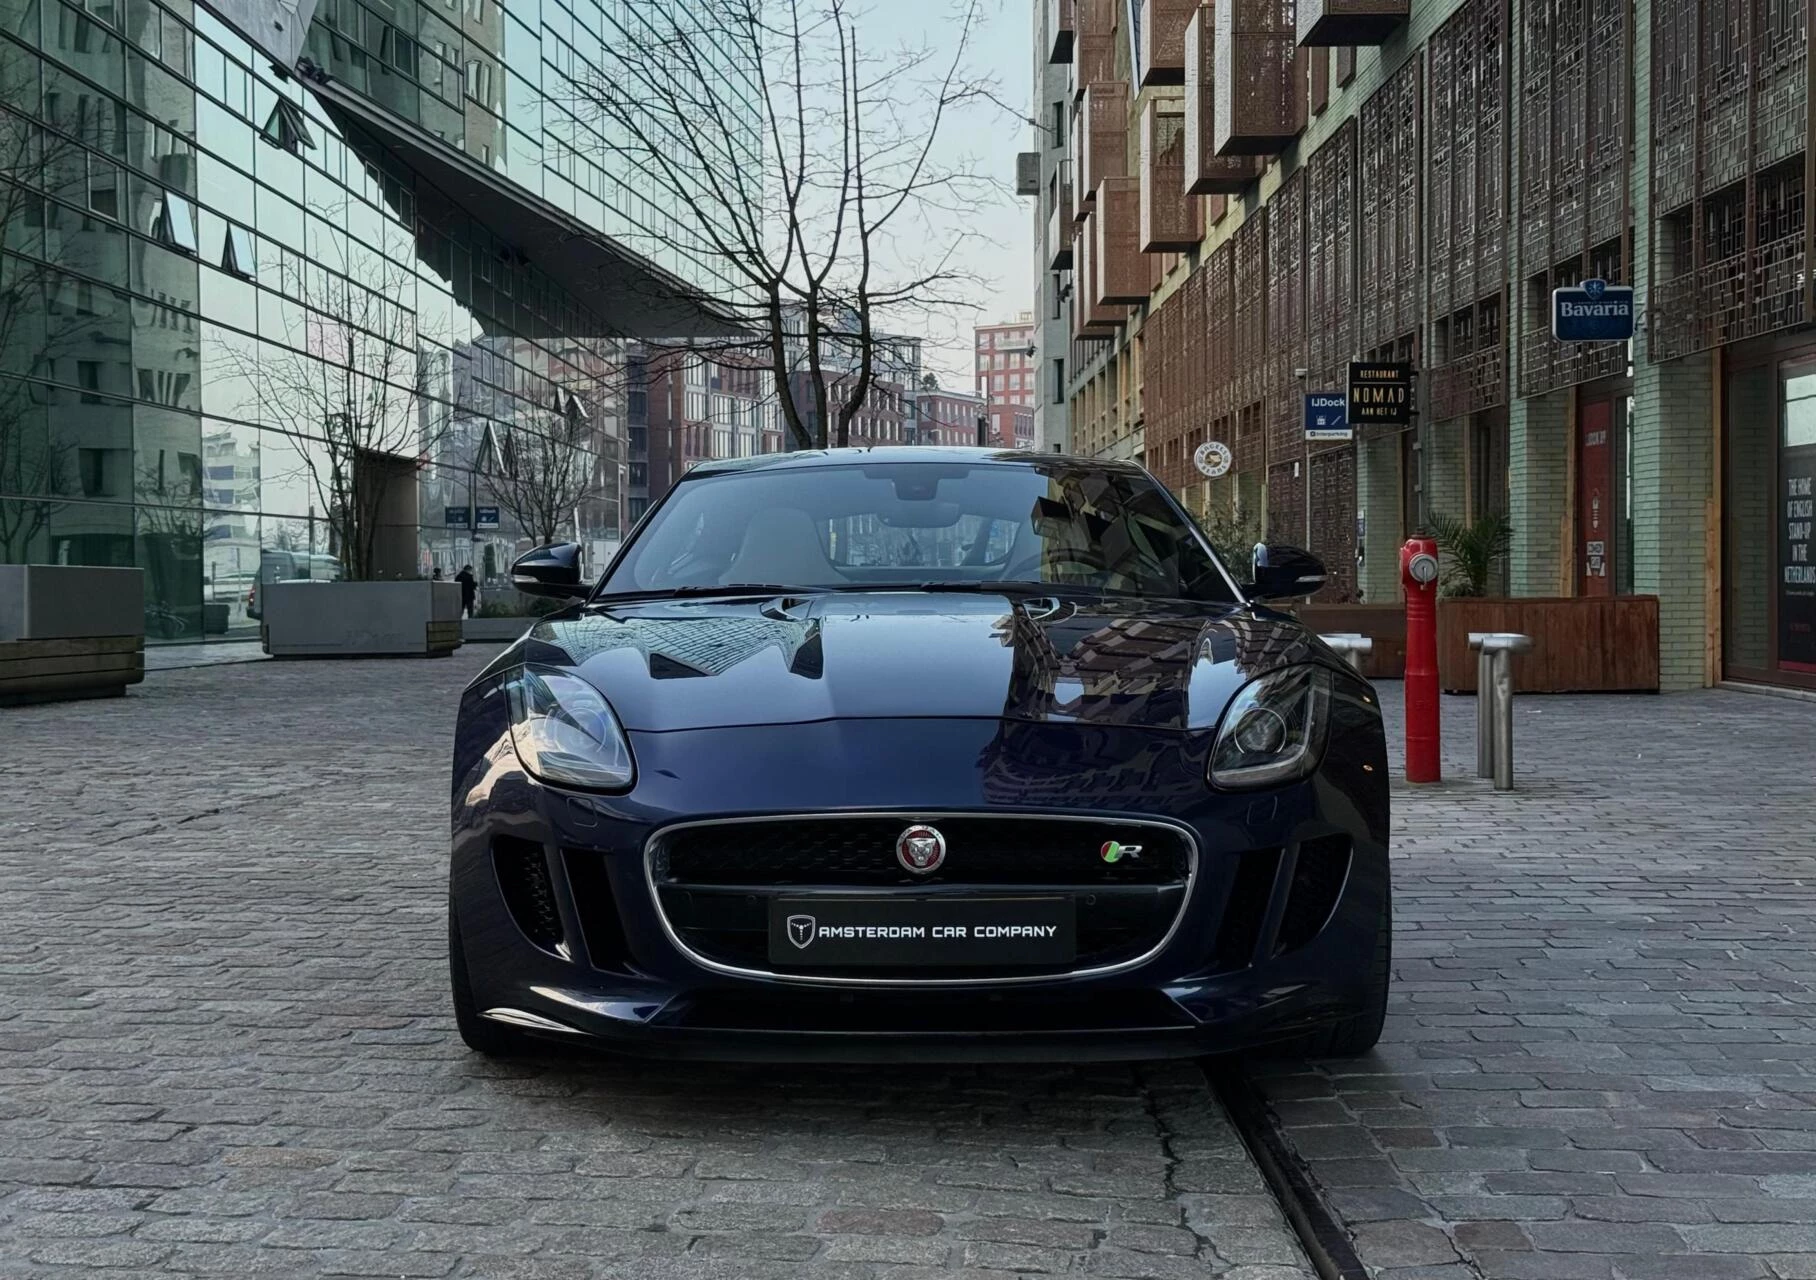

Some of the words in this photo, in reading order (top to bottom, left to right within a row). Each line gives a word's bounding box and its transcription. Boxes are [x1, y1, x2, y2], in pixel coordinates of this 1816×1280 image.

[1560, 301, 1630, 317] Bavaria
[1360, 370, 1399, 379] RESTAURANT
[1353, 387, 1405, 403] NOMAD
[1311, 398, 1345, 407] IJDock
[1361, 407, 1373, 416] AAN
[818, 926, 926, 938] AMSTERDAM
[931, 926, 968, 938] CAR
[973, 925, 1058, 938] COMPANY
